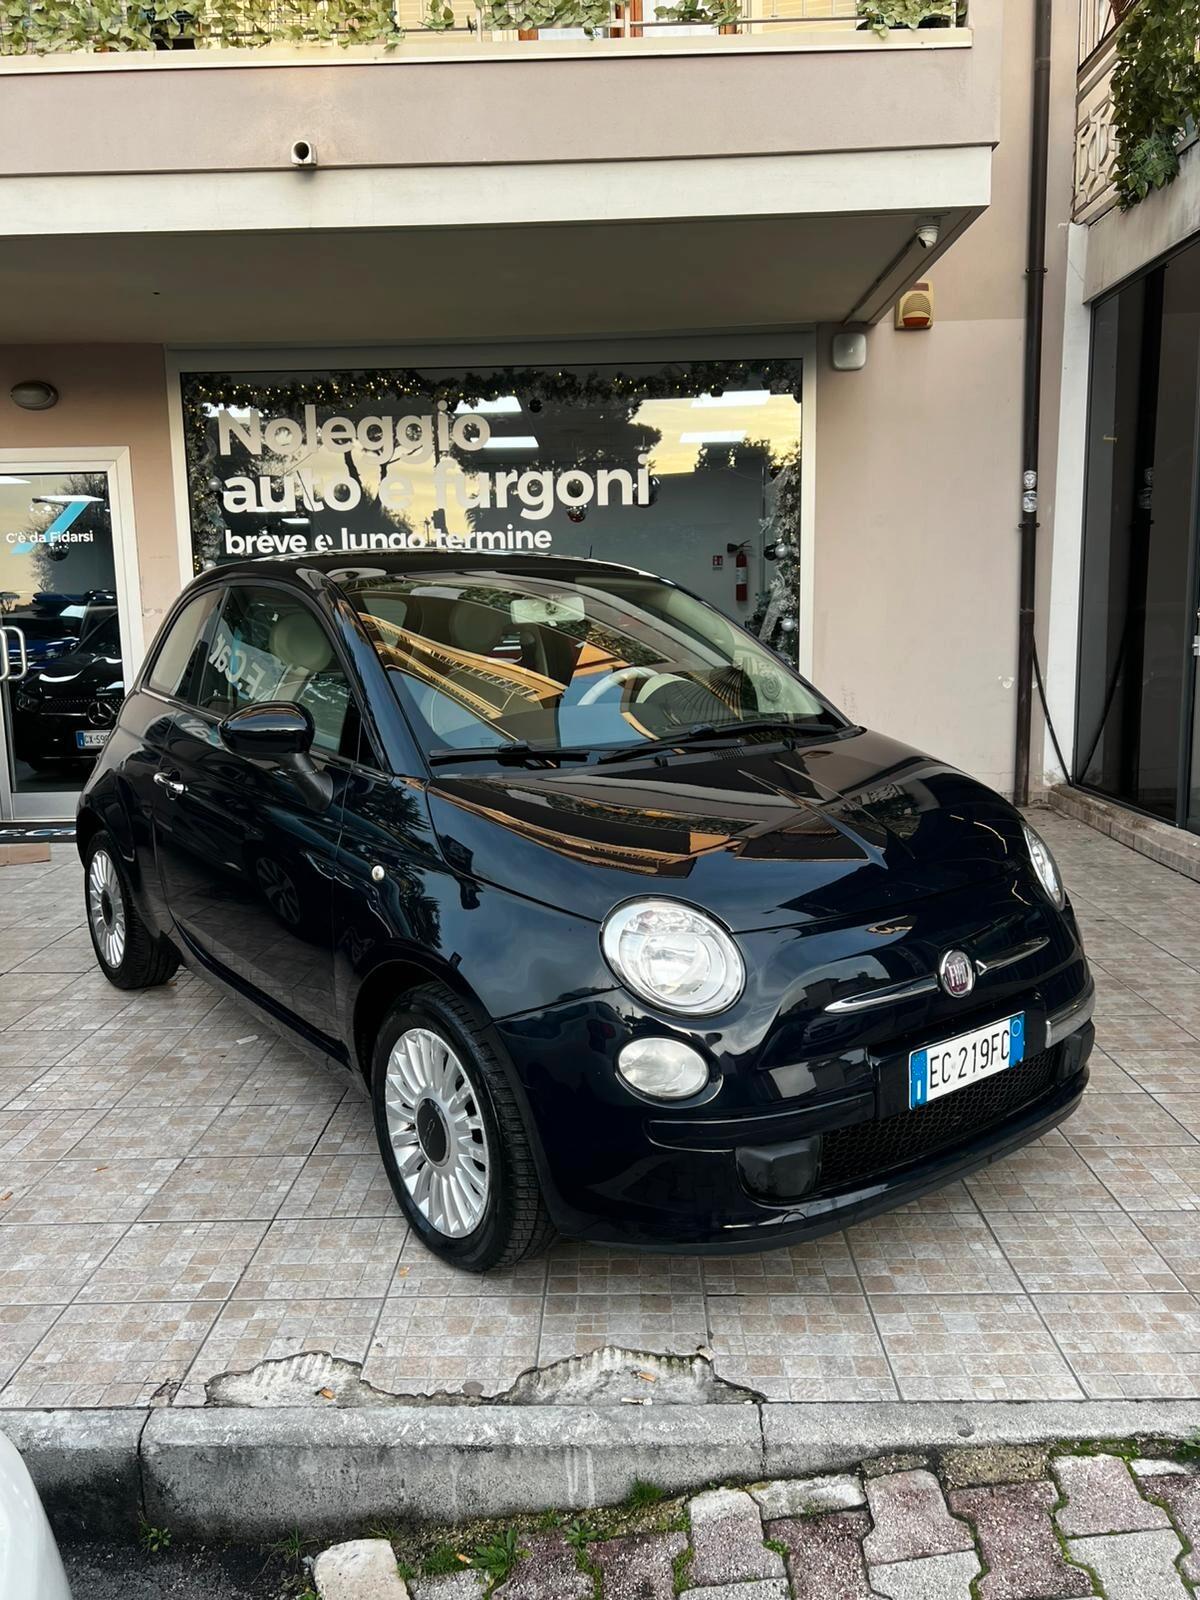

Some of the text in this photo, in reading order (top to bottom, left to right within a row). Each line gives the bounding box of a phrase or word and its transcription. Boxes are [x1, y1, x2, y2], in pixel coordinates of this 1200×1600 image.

[218, 400, 490, 465] Noleggio
[222, 453, 650, 520] auto e furgoni
[6, 529, 94, 544] C'è da Fidarsi
[225, 529, 308, 554] breve
[314, 534, 334, 551] e
[436, 523, 553, 550] termine
[947, 961, 966, 988] FIAT
[929, 1052, 951, 1090] EC
[957, 1029, 1010, 1080] 219FC
